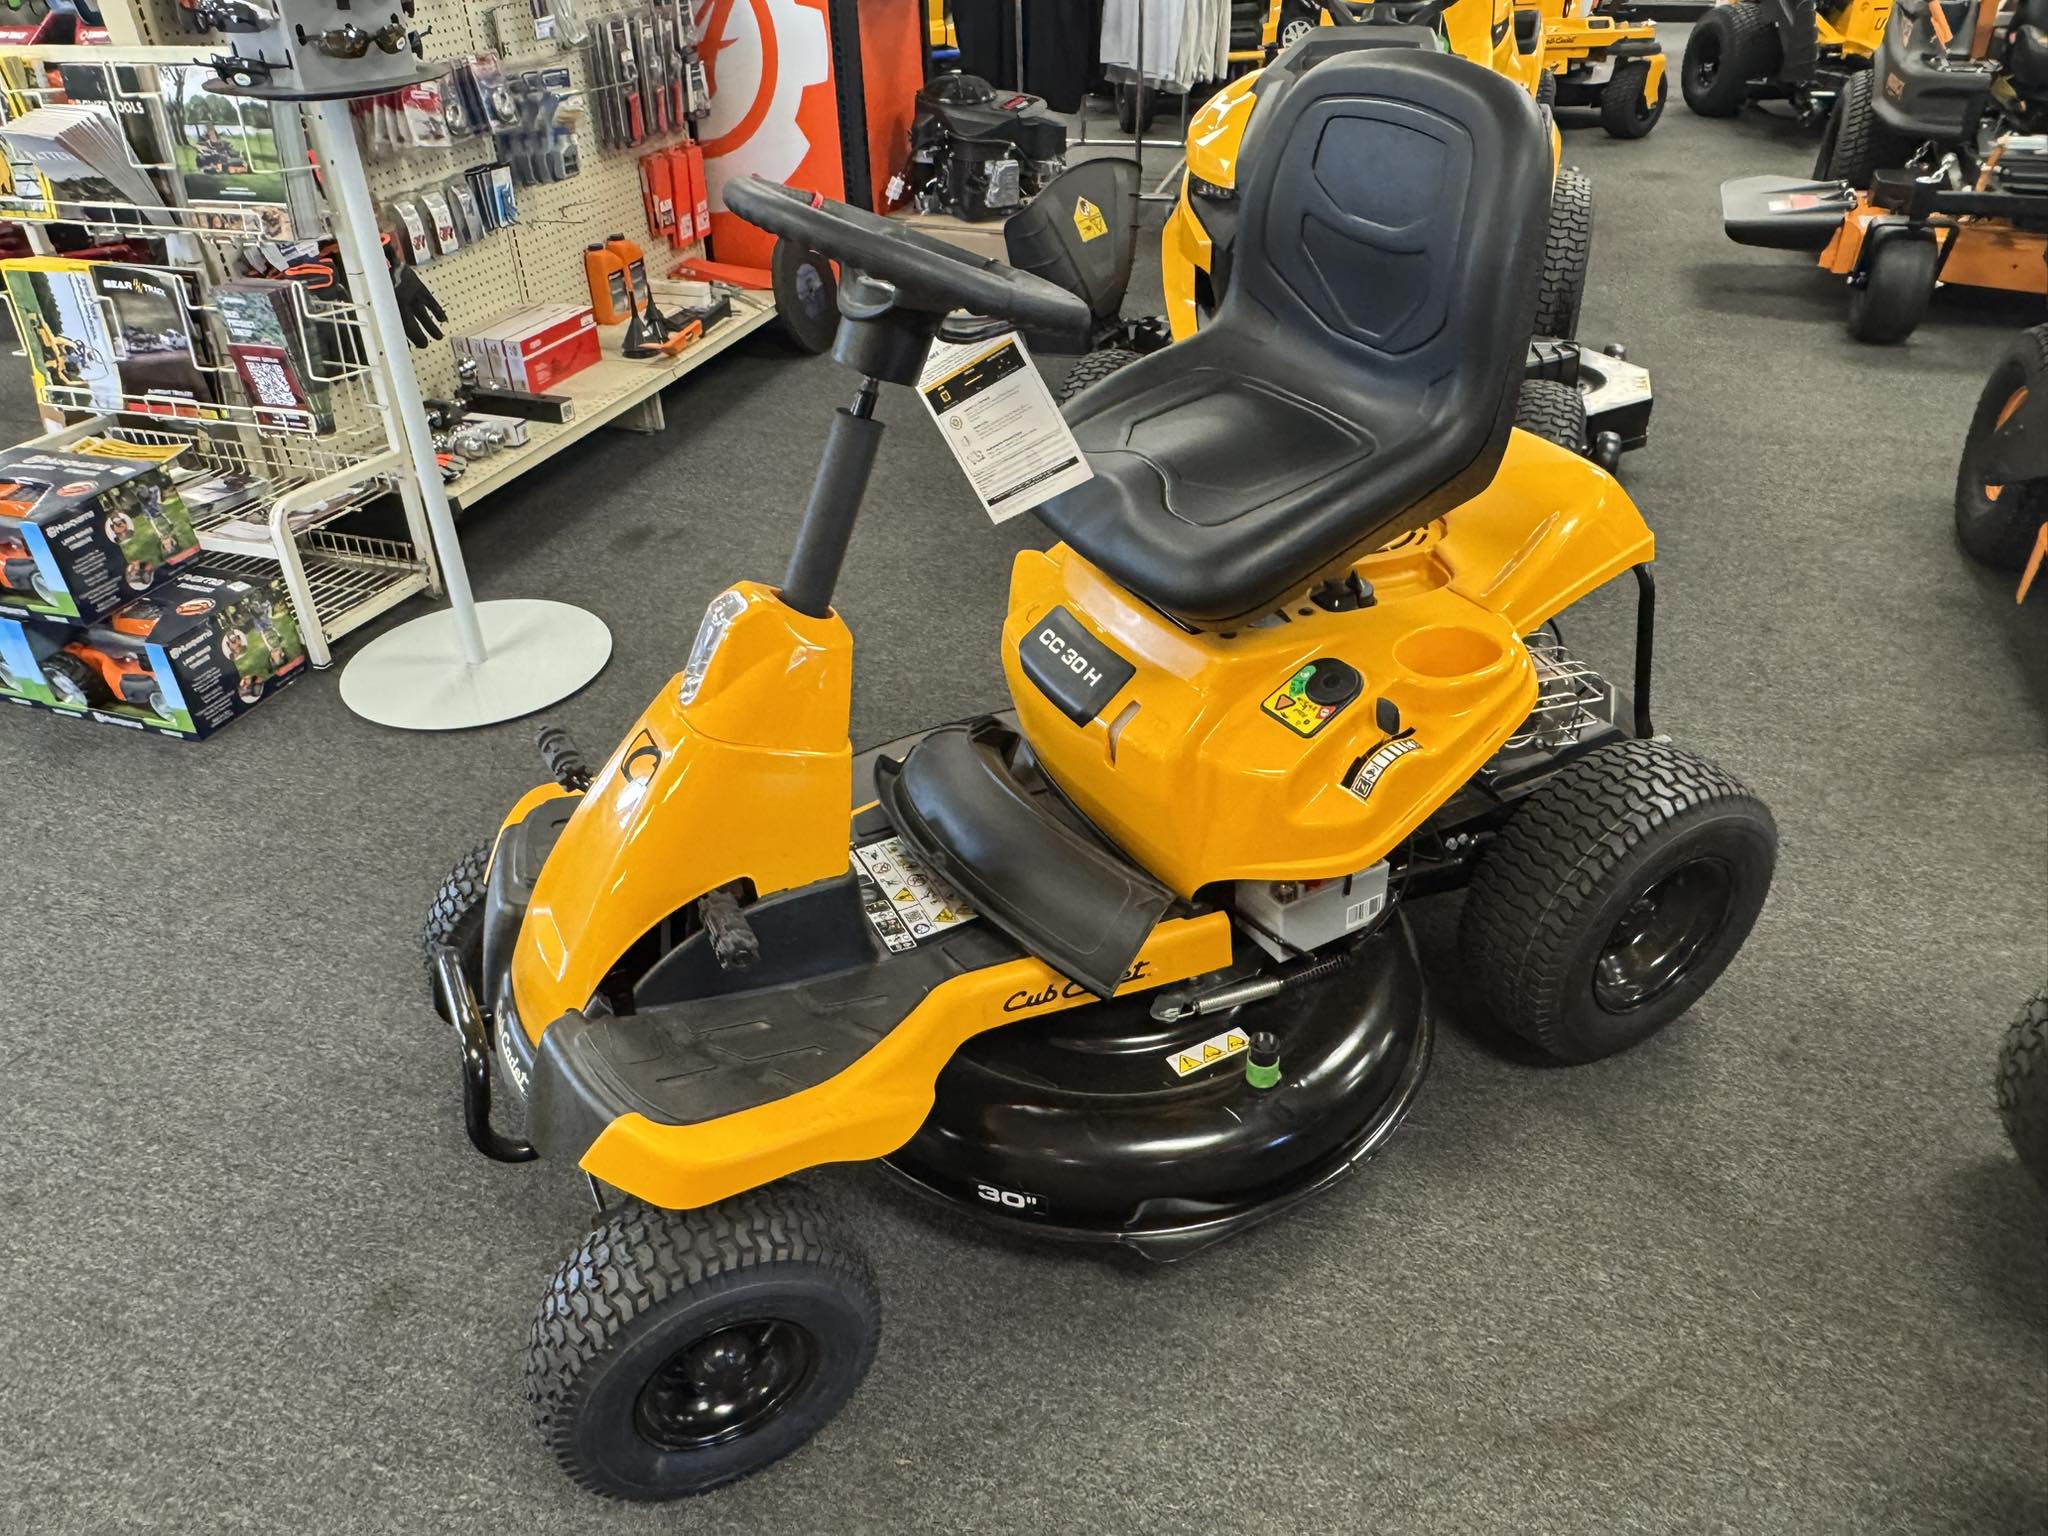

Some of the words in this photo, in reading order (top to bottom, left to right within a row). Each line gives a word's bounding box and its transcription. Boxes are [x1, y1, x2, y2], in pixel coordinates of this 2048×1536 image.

[1039, 628, 1066, 654] CC
[1003, 984, 1058, 1012] Cub
[501, 1031, 530, 1098] Cadet
[977, 1184, 1037, 1208] 30"
